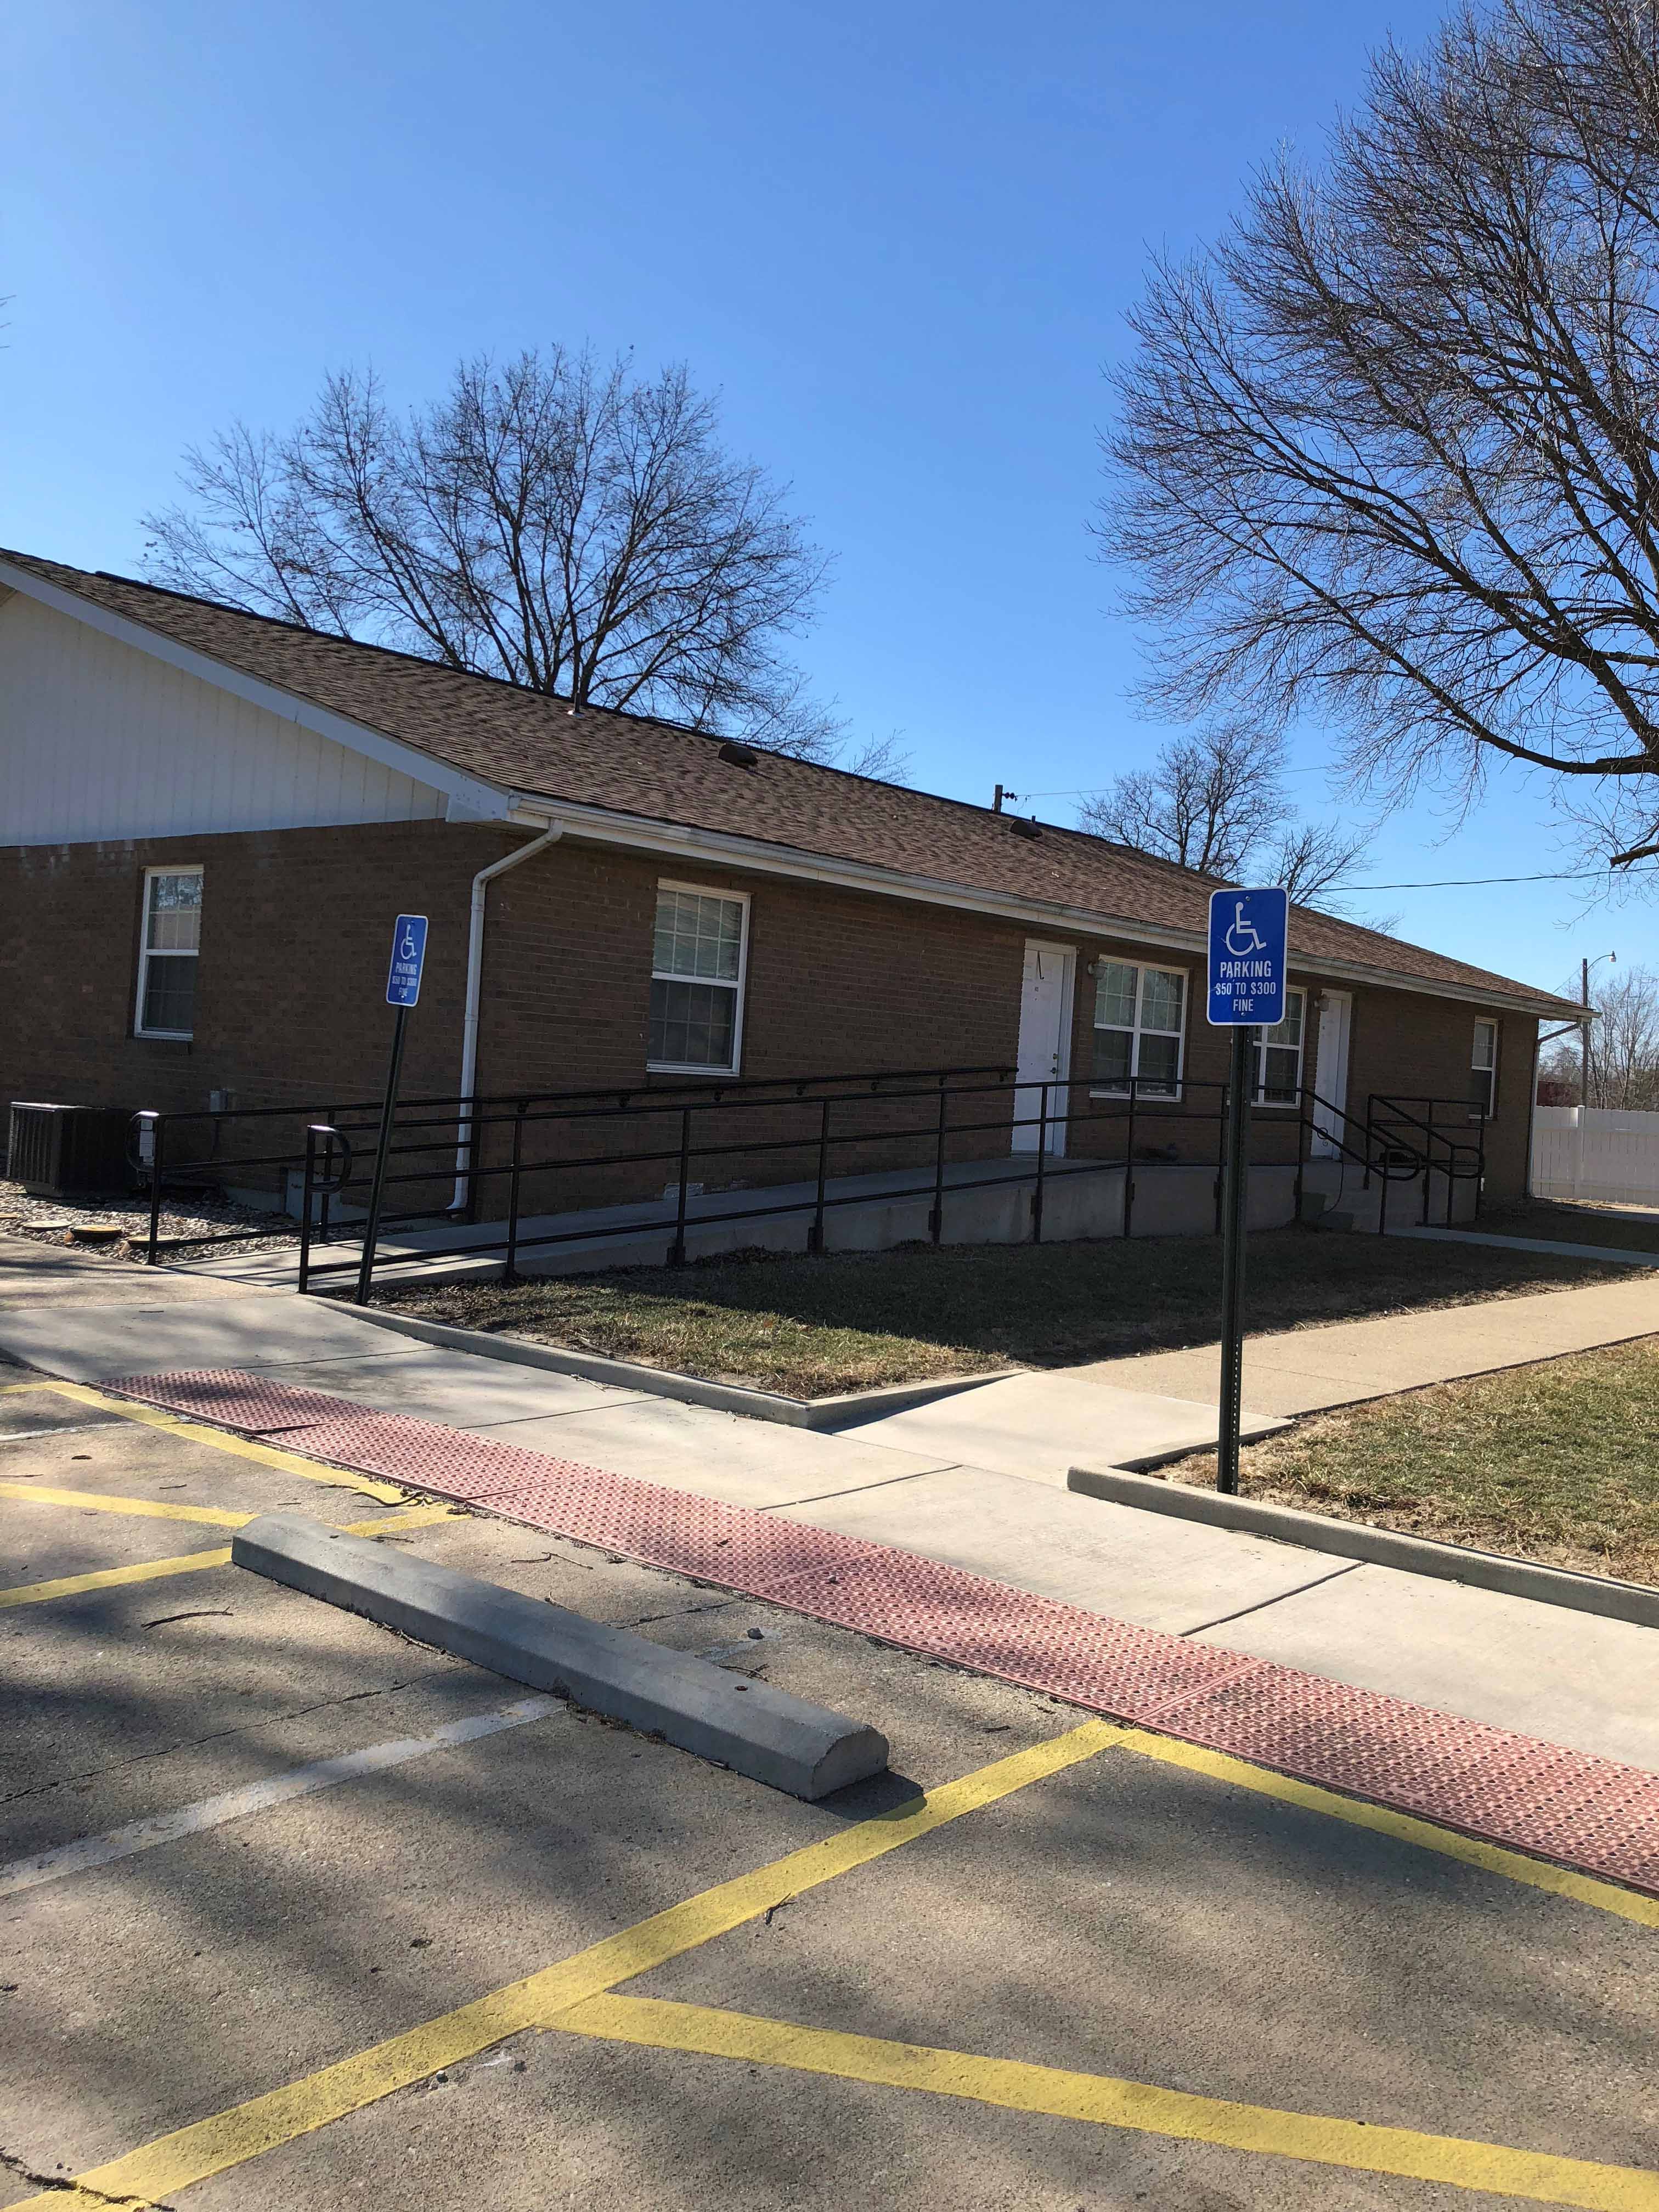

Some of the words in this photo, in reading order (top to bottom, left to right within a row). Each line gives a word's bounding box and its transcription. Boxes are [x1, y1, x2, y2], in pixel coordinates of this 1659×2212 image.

[1220, 961, 1272, 978] PARKING
[1215, 983, 1232, 995] $50
[1235, 983, 1246, 995] TO
[1250, 982, 1276, 995] $300
[1233, 999, 1254, 1012] FINE
